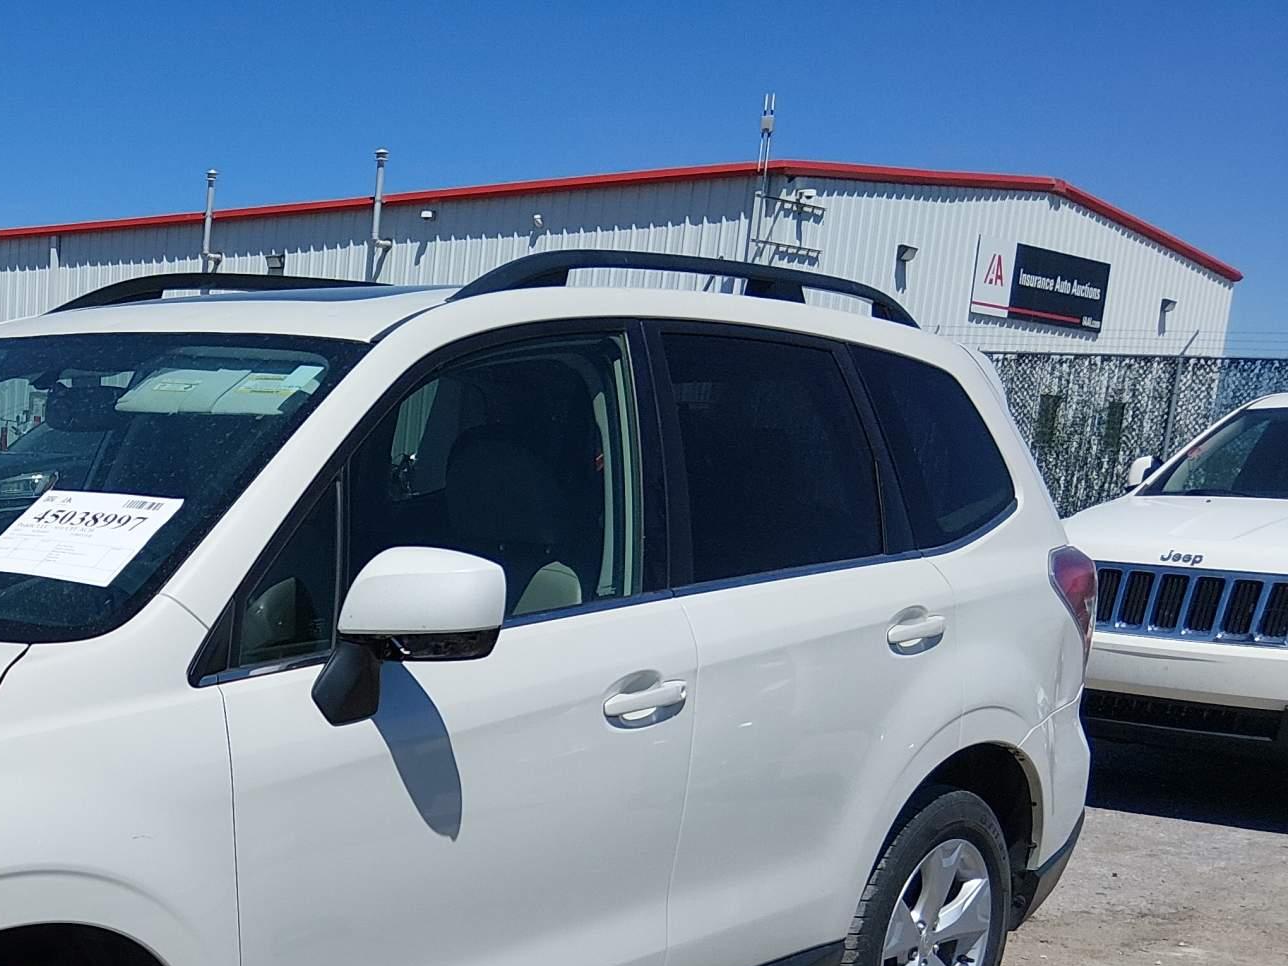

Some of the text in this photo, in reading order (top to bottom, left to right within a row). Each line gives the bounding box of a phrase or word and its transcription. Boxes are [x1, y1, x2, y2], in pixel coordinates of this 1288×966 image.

[1019, 268, 1101, 300] Insurance Auto Auctions
[33, 508, 149, 532] 45038997
[1160, 549, 1204, 566] Jeep
